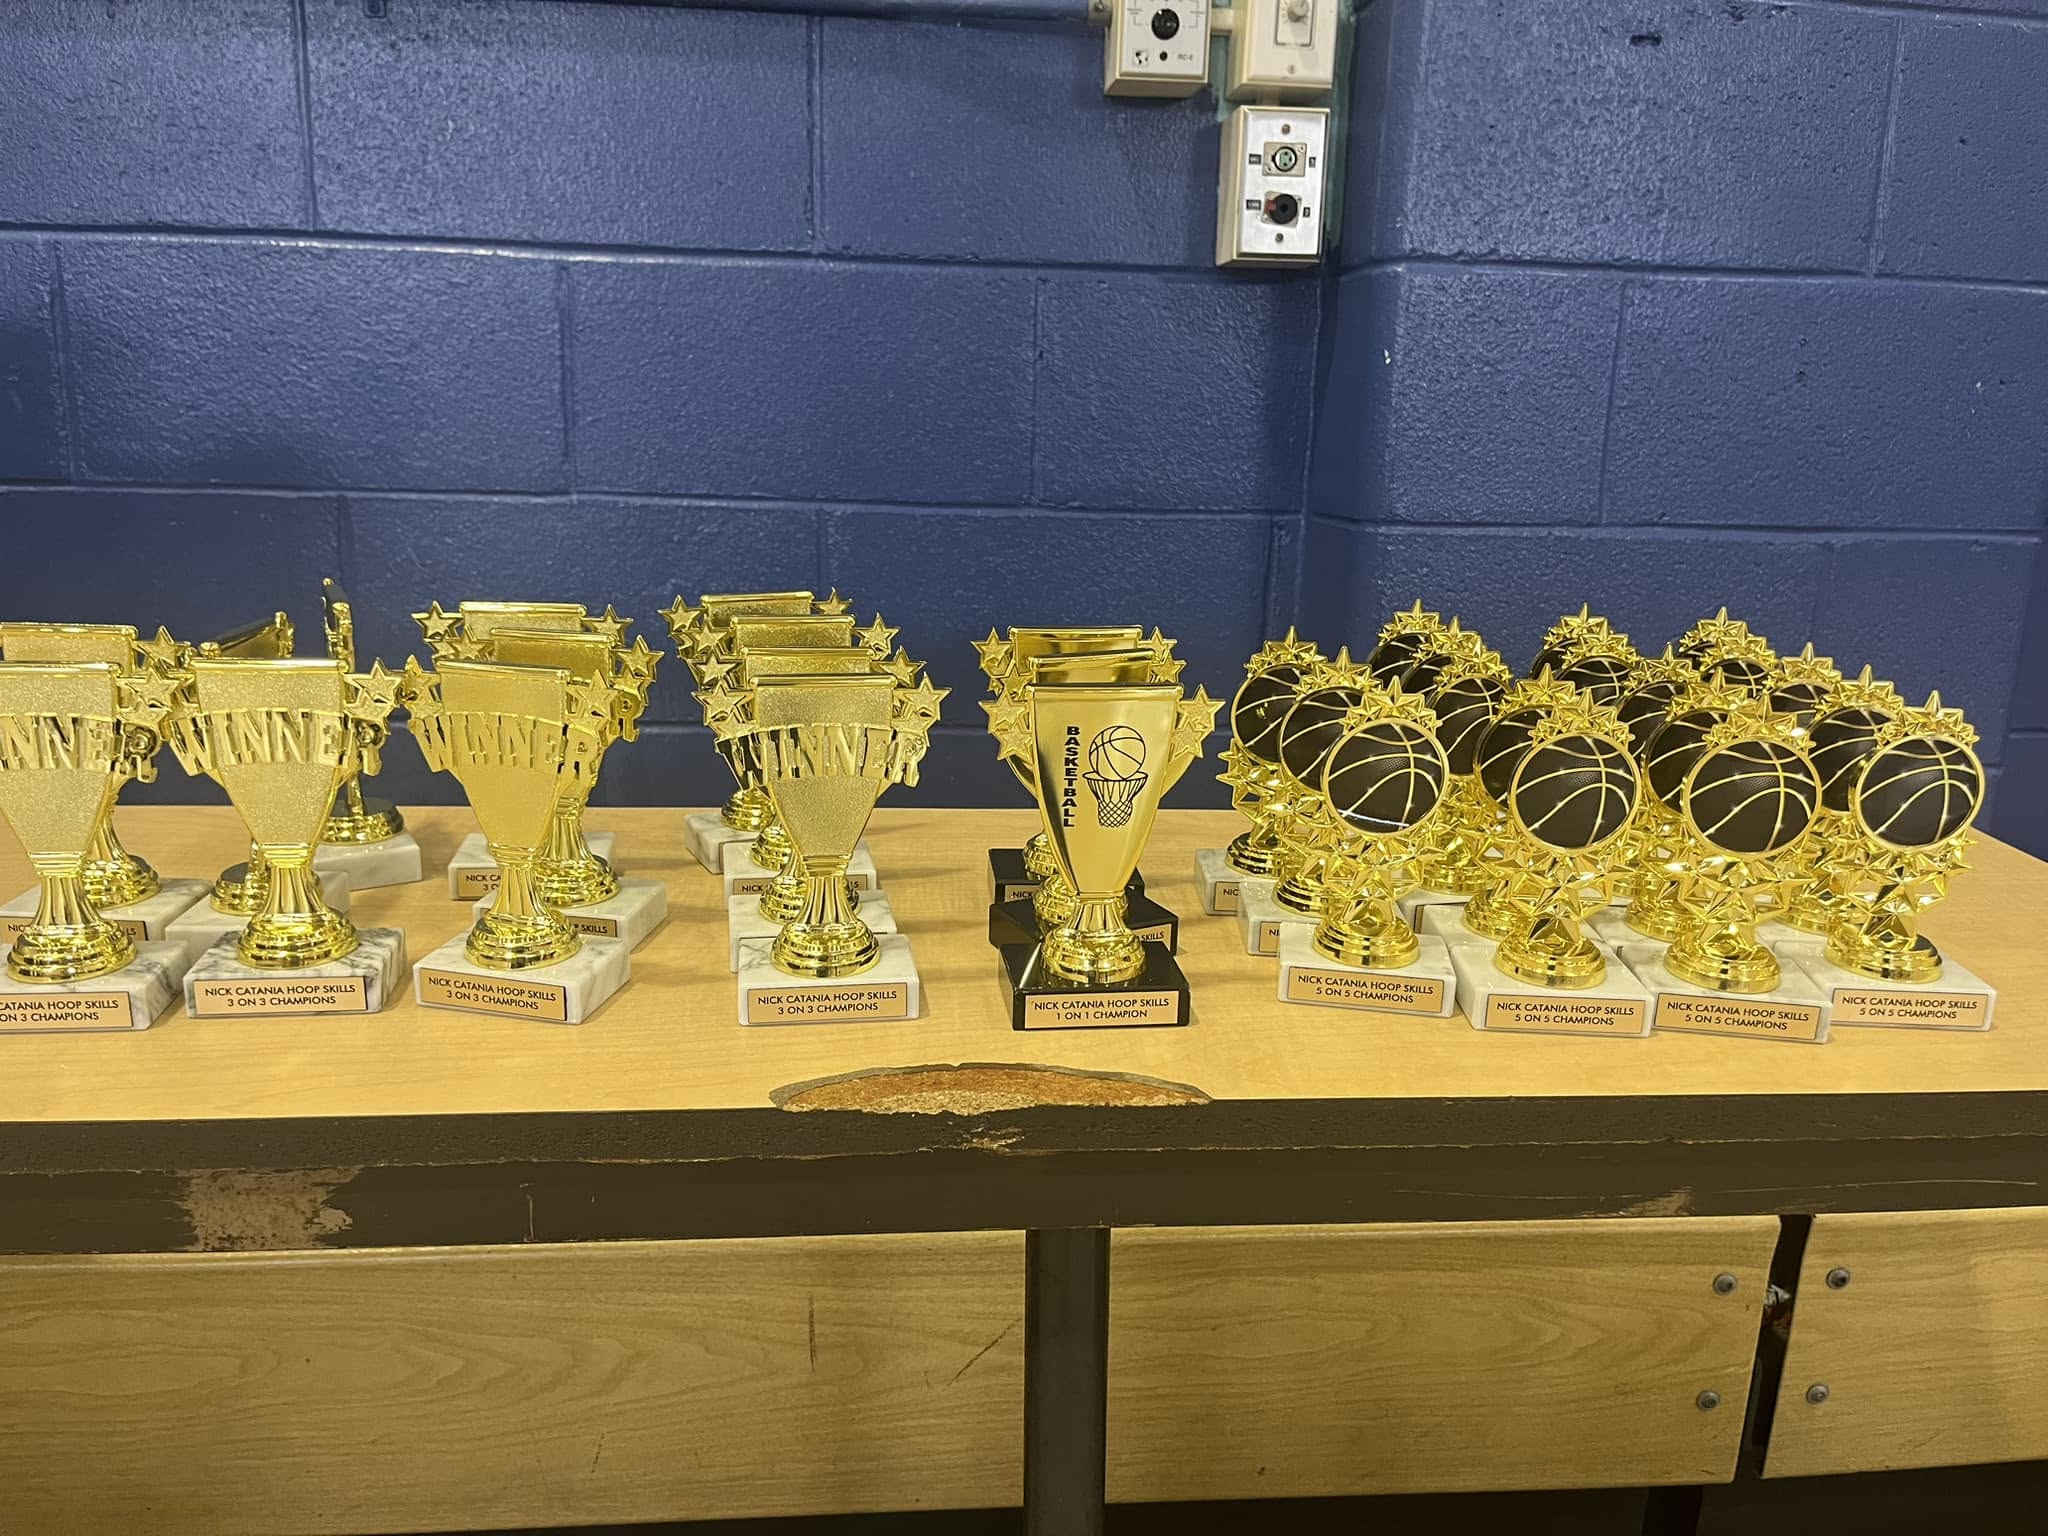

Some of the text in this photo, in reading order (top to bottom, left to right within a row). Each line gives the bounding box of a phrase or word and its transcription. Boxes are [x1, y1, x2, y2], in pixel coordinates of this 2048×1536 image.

[0, 711, 160, 784] NNER
[167, 708, 385, 776] WINNER
[409, 711, 603, 781] WINNER
[715, 723, 928, 790] WINNER
[1061, 725, 1081, 828] BASKETBALL
[741, 884, 763, 893] NICK
[1223, 888, 1240, 897] NIC
[7, 924, 25, 933] NIC
[581, 924, 608, 934] SKILLS
[1141, 931, 1165, 941] SKILLS
[205, 985, 356, 996] NICK CATANIA HOOP SKILLS
[429, 977, 556, 1001] NICK CATANIA HOOP SKILLS
[1298, 975, 1433, 994] NICK CATANIA HOOP SKILLS
[446, 990, 453, 998] 3
[455, 991, 471, 1000] ON
[482, 995, 539, 1010] CHAMPIONS
[758, 991, 897, 1005] NICK CATANIA HOOP SKILLS
[1316, 987, 1414, 1003] 5 ON 5 CHAMPIONS
[48, 1001, 82, 1009] HOOP
[85, 1000, 119, 1009] SKILLS
[227, 996, 336, 1007] 3 ON 3 CHAMPIONS
[1035, 998, 1169, 1010] NICK CATANIA HOOP SKILLS
[1842, 997, 1977, 1009] NICK CATANIA HOOP SKILLS
[778, 1003, 878, 1015] 3 ON 3 CHAMPIONS
[1497, 1002, 1634, 1015] NICK CATANIA HOOP SKILLS
[1667, 1002, 1809, 1021] NICK CATANIA HOOP SKILLS
[1859, 1008, 1957, 1019] 5 ON 5 CHAMPIONS
[0, 1012, 99, 1021] ON 3 CHAMPIONS
[1056, 1010, 1147, 1020] 1 ON 1 CHAMPION
[1515, 1014, 1614, 1025] 5 ON 5 CHAMPIONS
[1685, 1014, 1788, 1030] 5 ON 5 CHAMPIONS
